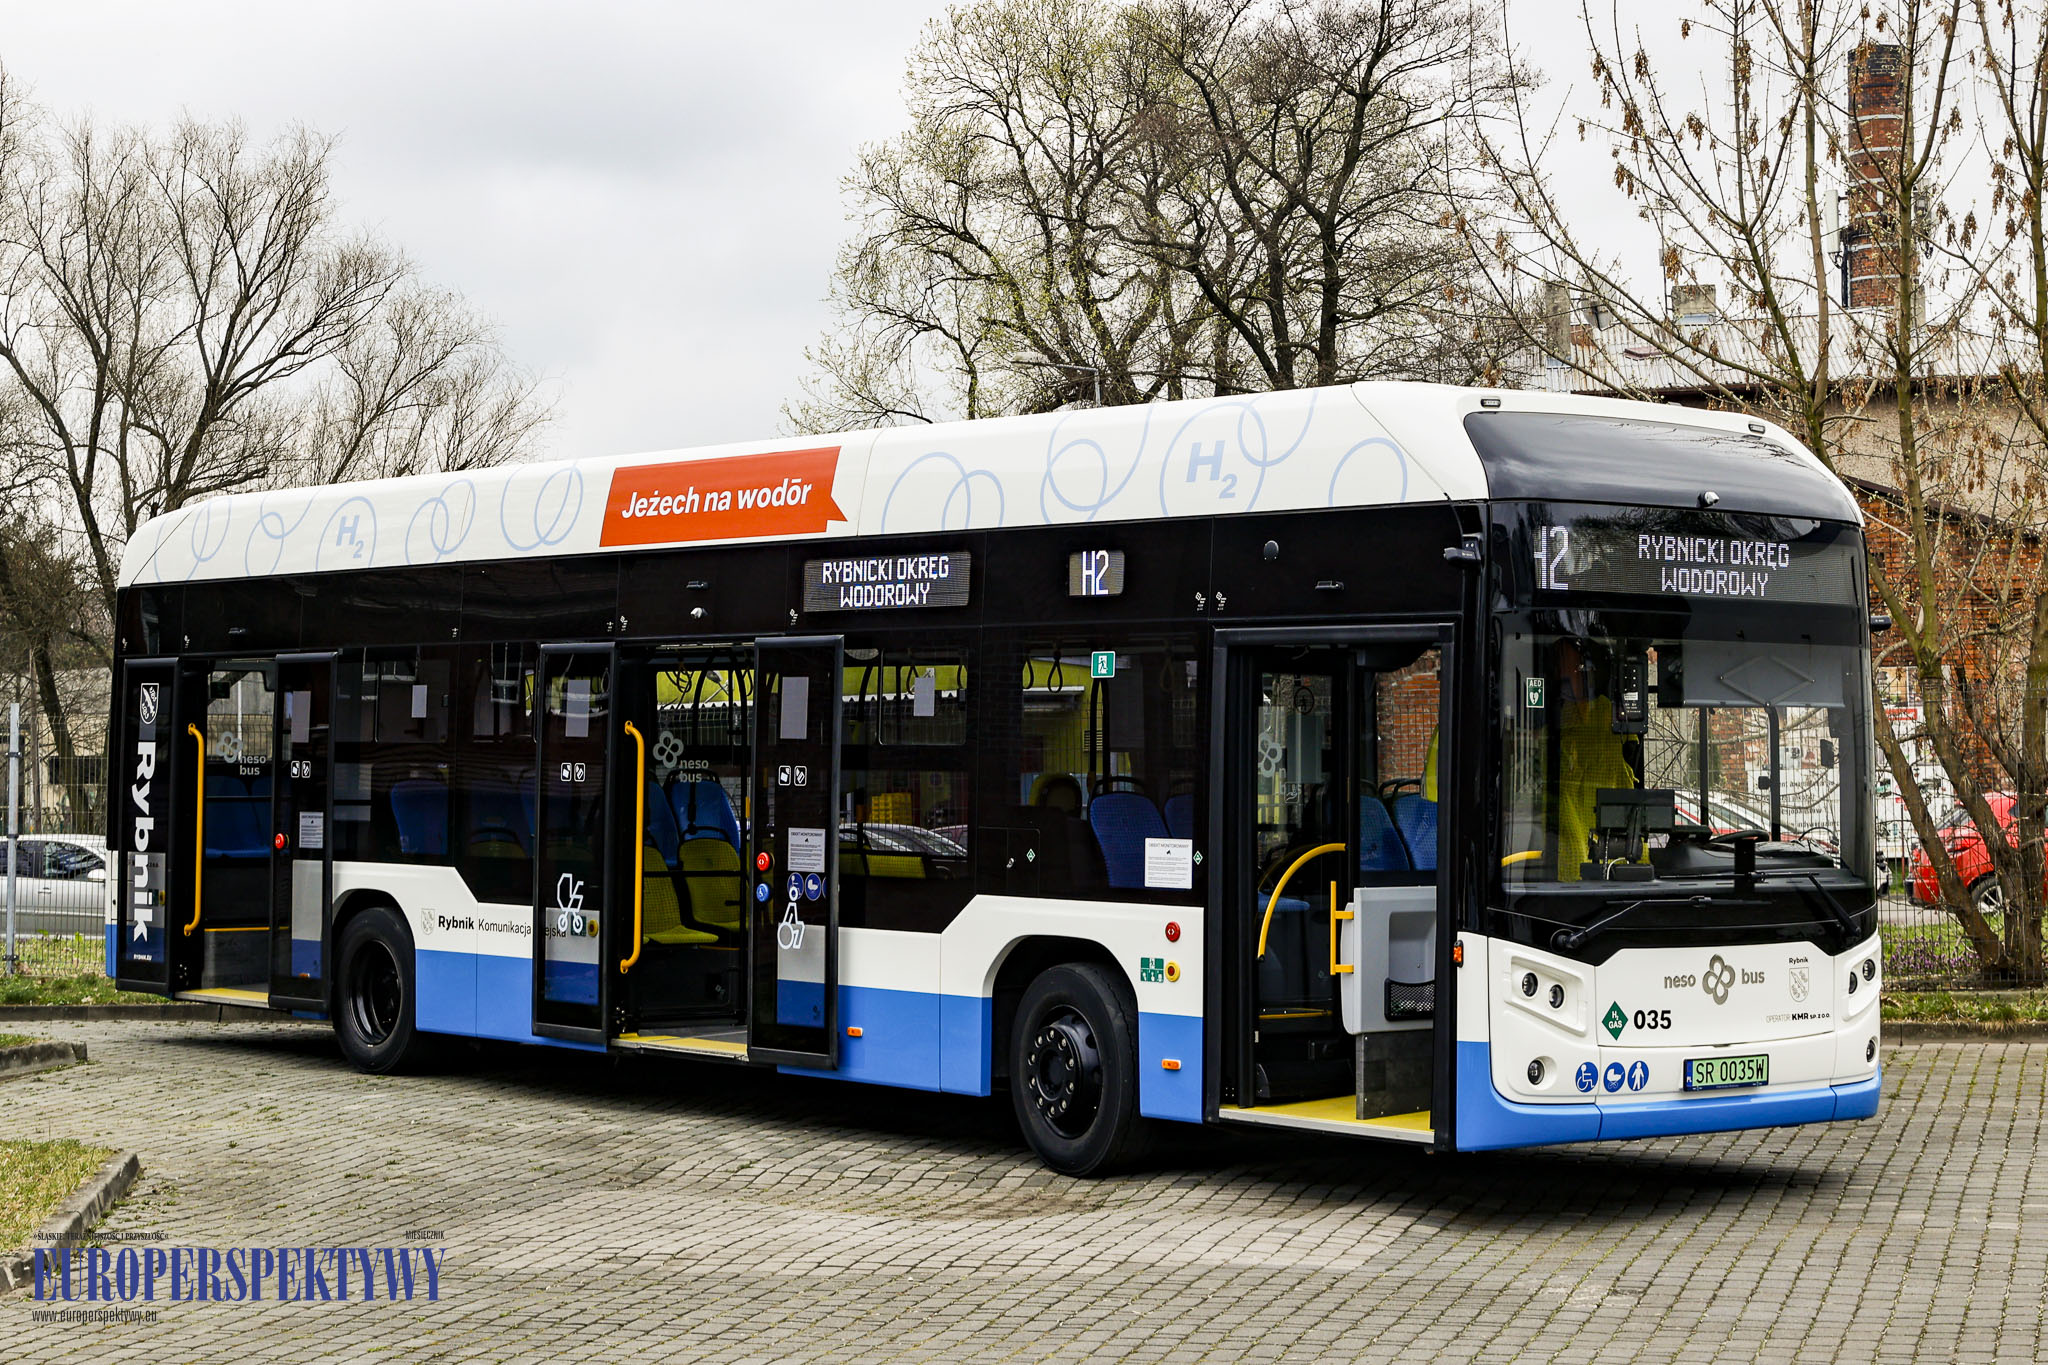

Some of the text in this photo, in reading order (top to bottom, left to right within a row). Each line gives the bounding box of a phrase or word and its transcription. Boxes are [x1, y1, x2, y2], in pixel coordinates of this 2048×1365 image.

[621, 486, 700, 518] Jeżech
[703, 490, 732, 512] na
[1638, 534, 1790, 570] RYBNICKI OKRĘG
[822, 555, 950, 583] RYBNICKI OKRĘG
[1082, 550, 1109, 596] H2
[1661, 567, 1769, 597] WODOROWY
[840, 582, 930, 608] WODOROWY
[240, 755, 267, 764] neso
[240, 764, 260, 775] bus
[680, 759, 709, 769] neso
[680, 770, 702, 783] bus
[131, 741, 157, 943] Rybnik
[438, 915, 475, 931] Rybnik
[478, 918, 532, 937] Komunikacja
[1788, 956, 1809, 965] Rybnik
[1664, 968, 1765, 989] neso bus
[1608, 1020, 1623, 1029] GAS
[1633, 1009, 1672, 1030] 035
[1791, 1012, 1809, 1021] KMR
[1696, 1058, 1764, 1083] SR 0035W
